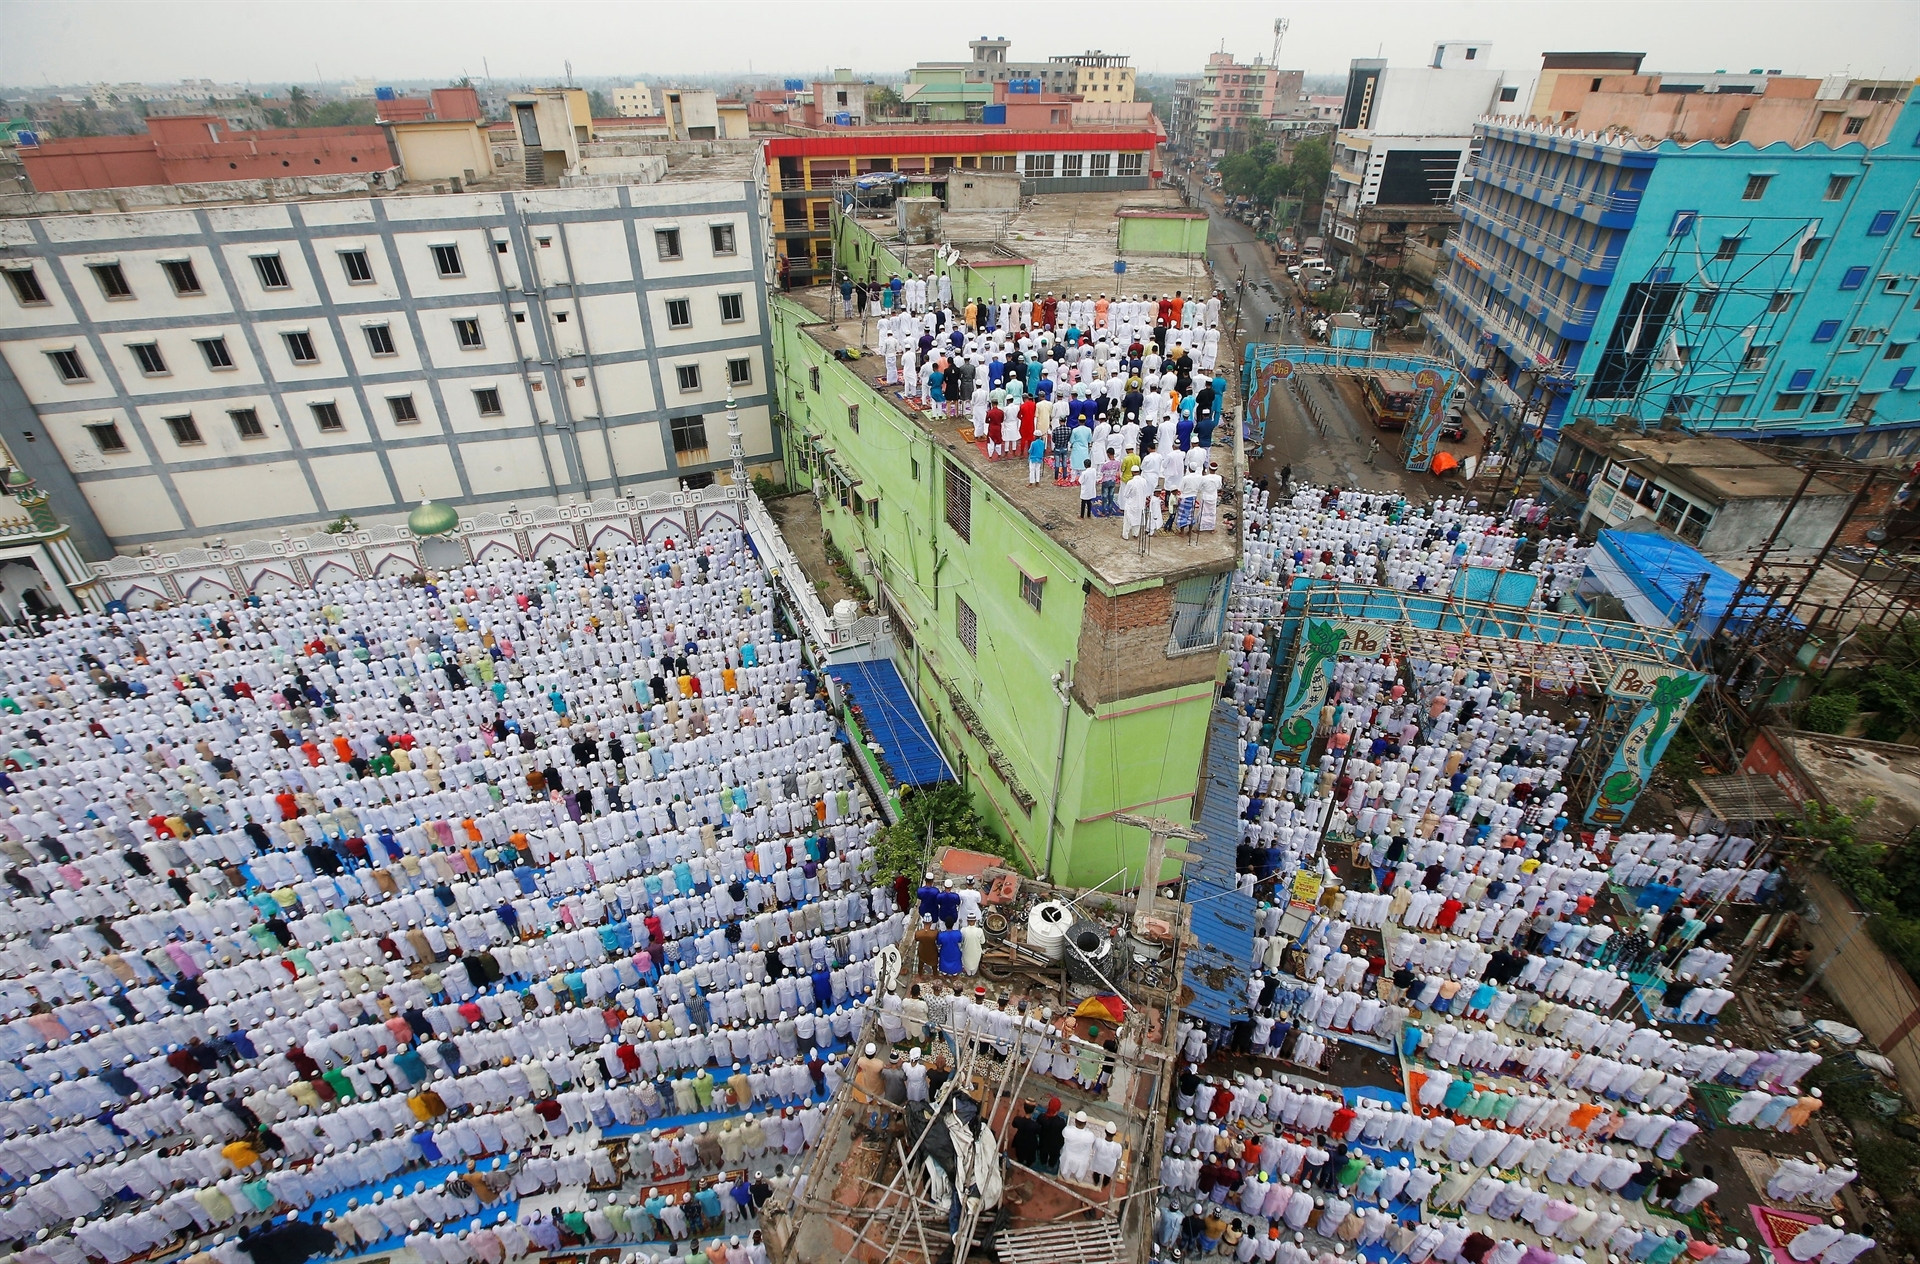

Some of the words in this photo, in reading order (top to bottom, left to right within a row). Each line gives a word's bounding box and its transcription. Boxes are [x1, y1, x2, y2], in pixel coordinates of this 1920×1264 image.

[1272, 362, 1289, 374] Dha
[1418, 372, 1434, 385] Dha
[1353, 629, 1378, 652] Ra
[1615, 668, 1643, 692] Ra
